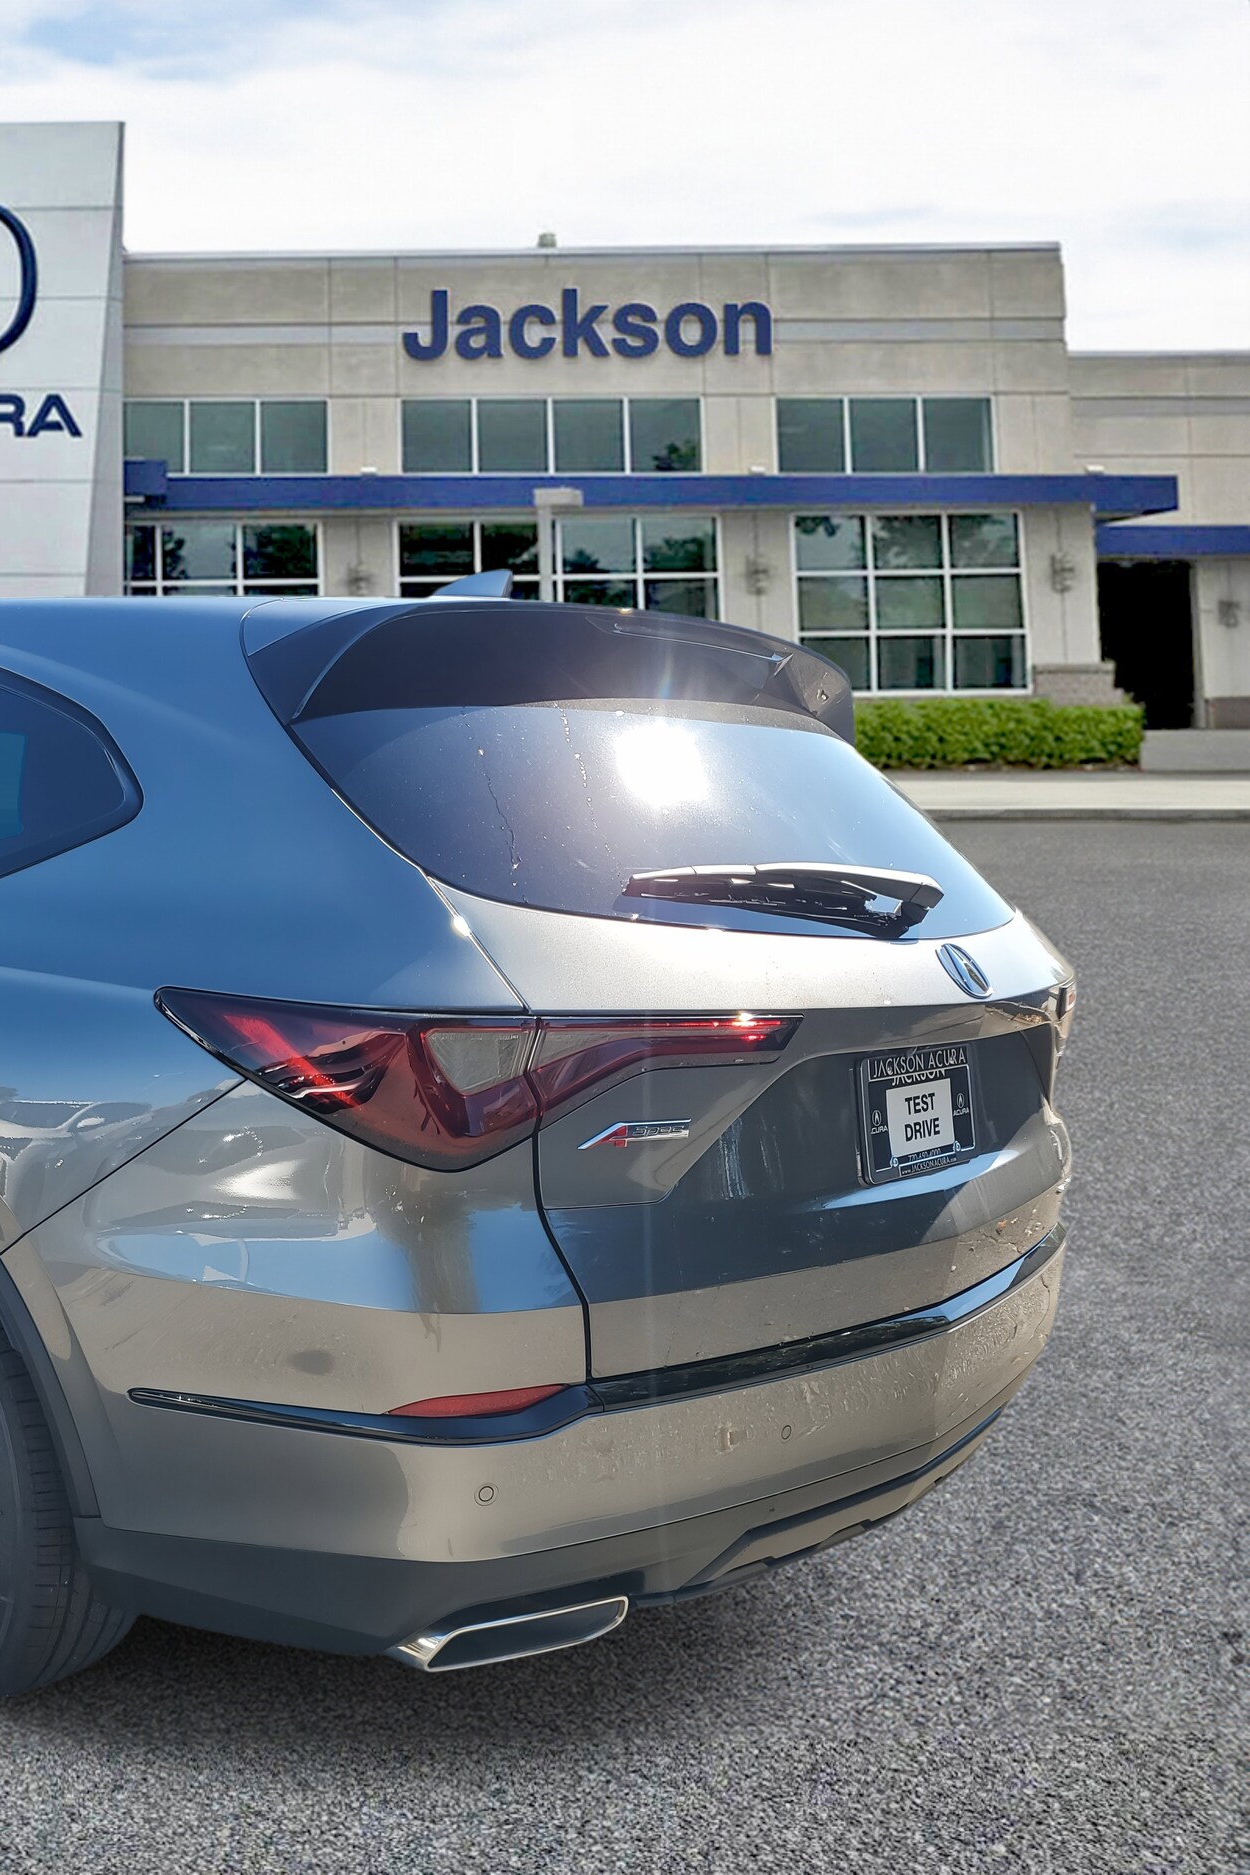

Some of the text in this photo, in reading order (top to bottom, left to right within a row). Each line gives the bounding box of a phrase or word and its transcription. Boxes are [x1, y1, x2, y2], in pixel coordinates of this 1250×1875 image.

[402, 288, 773, 361] Jackson
[873, 1047, 967, 1078] JACKSON ACURA
[904, 1092, 936, 1116] TEST
[870, 1125, 888, 1135] CURA
[904, 1117, 941, 1142] DRIVE
